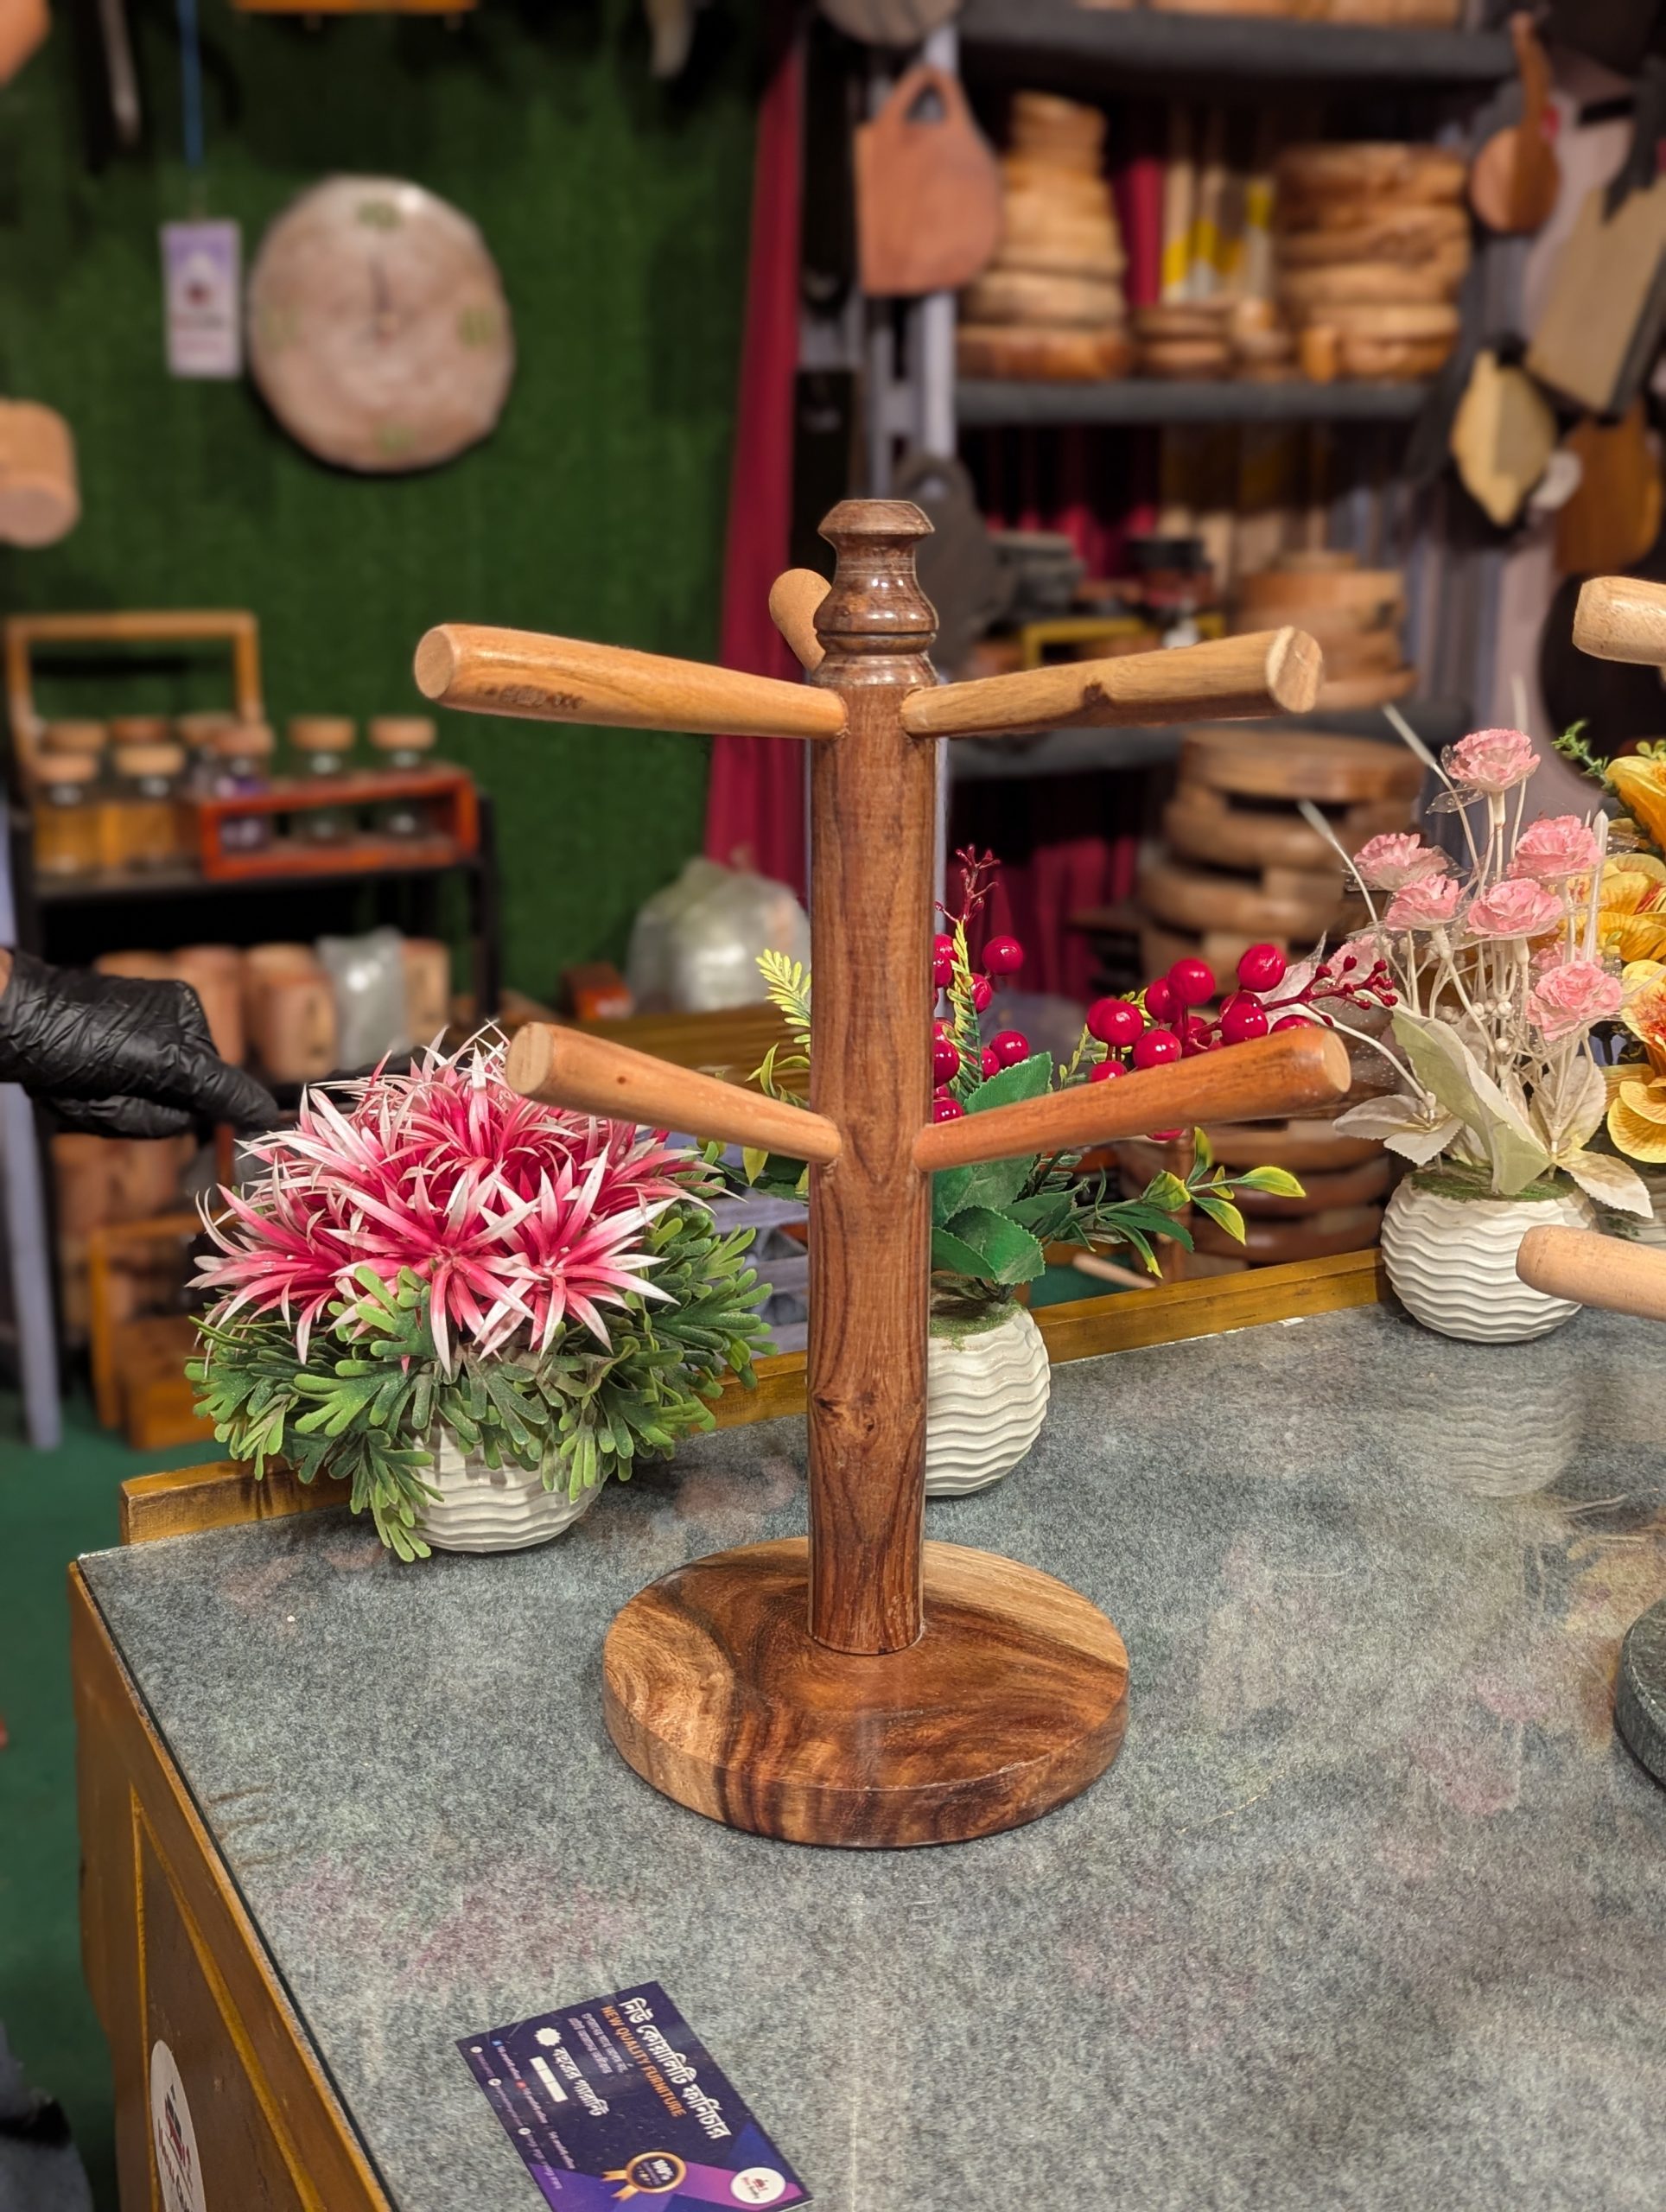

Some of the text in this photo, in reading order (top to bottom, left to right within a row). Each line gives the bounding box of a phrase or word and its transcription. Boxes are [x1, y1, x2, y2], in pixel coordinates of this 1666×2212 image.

[552, 2046, 609, 2116] বছরের গ্যারান্টি
[601, 2005, 687, 2117] NEW QUALITY FURNITURE
[618, 1997, 732, 2139] নিউ কোয়ালিটি ফার্নিচার
[652, 2158, 676, 2181] 100%
